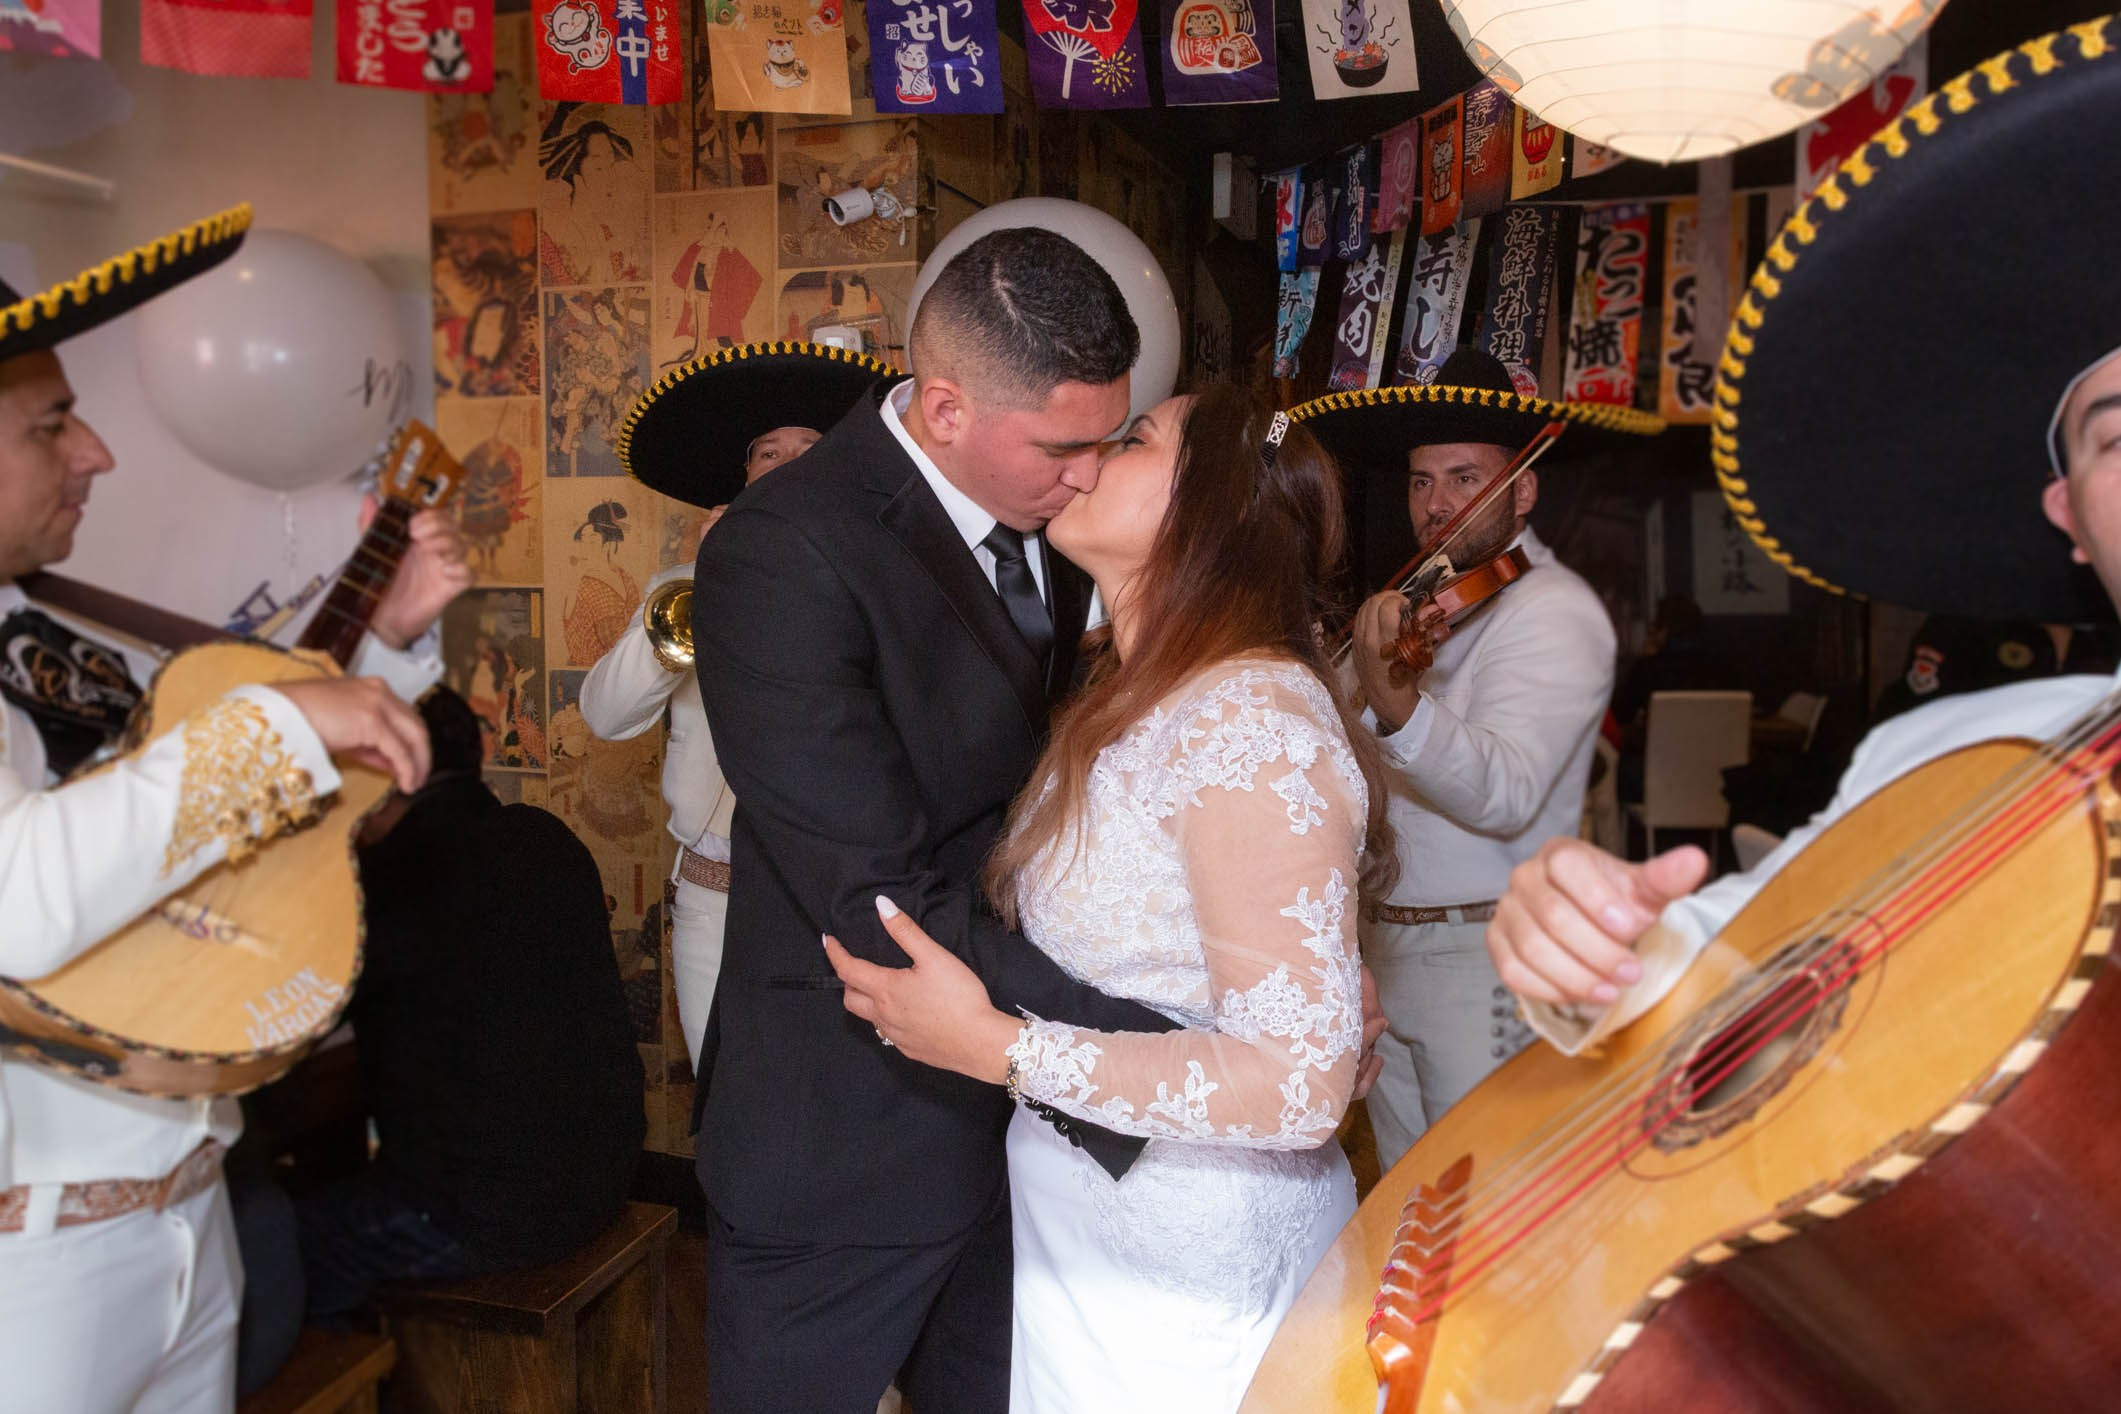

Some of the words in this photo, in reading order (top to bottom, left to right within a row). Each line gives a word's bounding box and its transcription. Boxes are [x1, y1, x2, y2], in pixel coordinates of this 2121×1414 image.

[1338, 244, 1386, 358] 焼肉
[1411, 225, 1456, 361] 寿し
[1489, 208, 1544, 366] 海鮮料理
